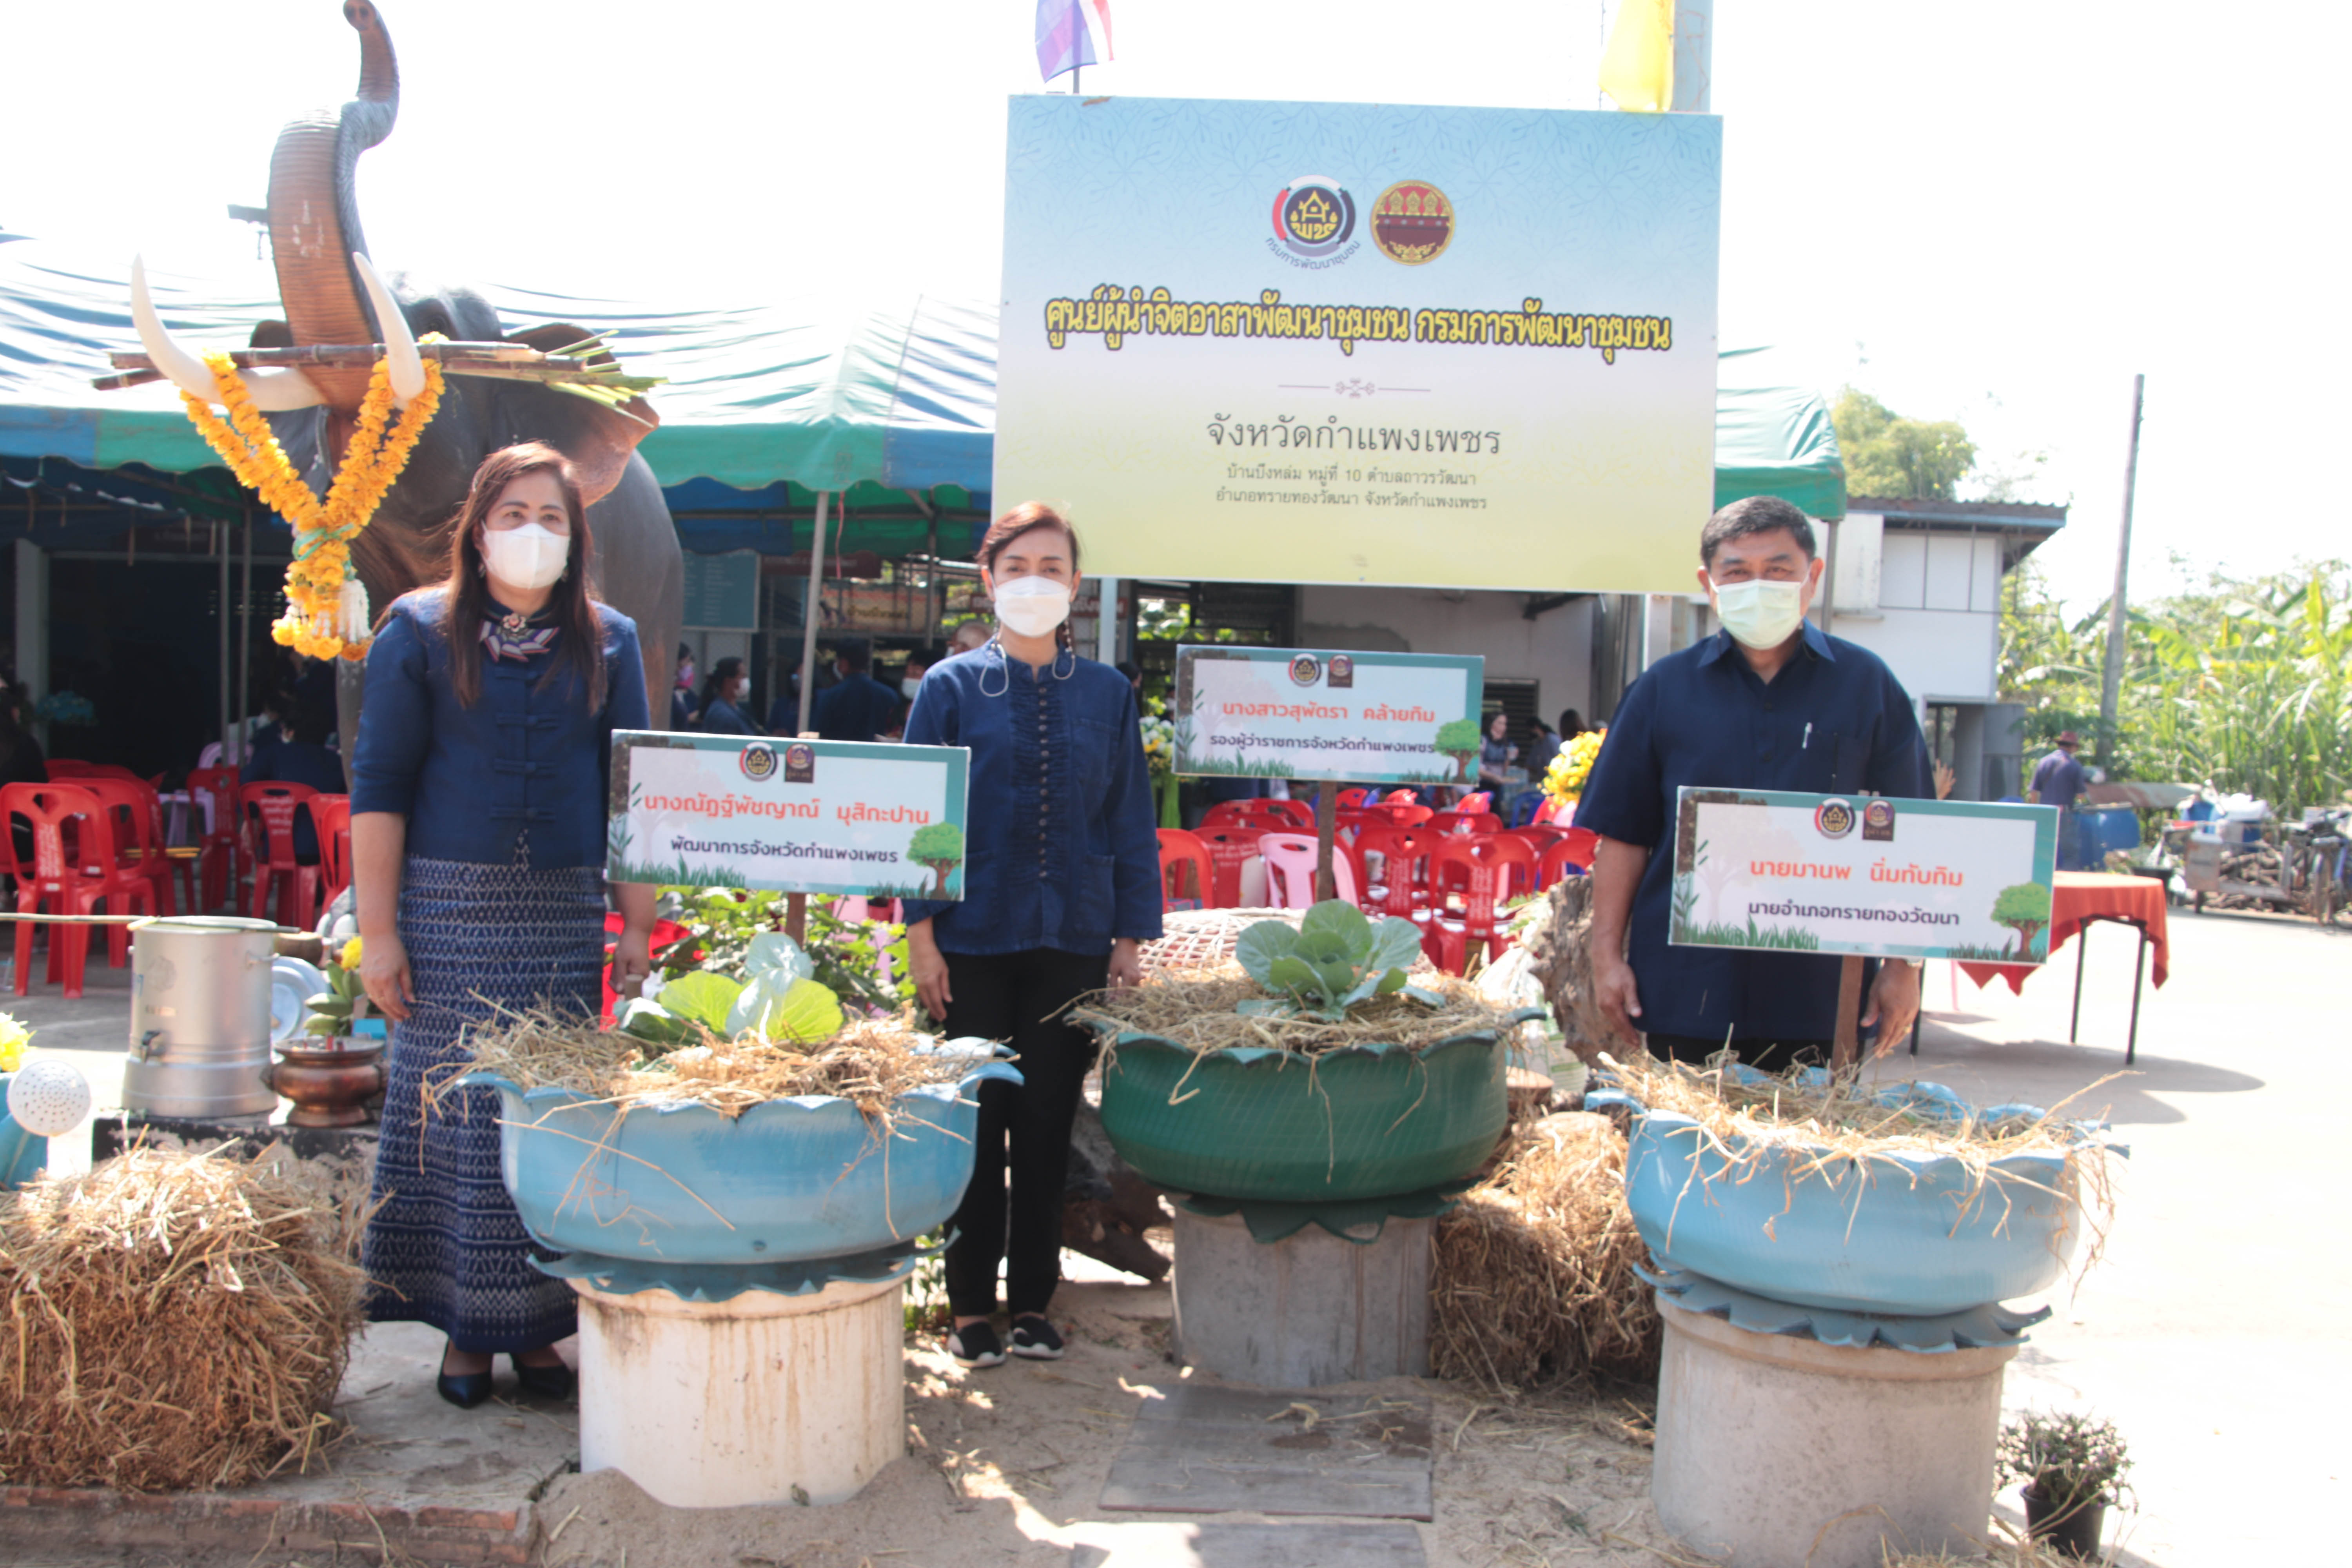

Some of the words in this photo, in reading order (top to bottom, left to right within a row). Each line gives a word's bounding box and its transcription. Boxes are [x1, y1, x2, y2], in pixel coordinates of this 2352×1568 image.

[1265, 237, 1361, 269] กรมการพัฒนาชุมชน
[1045, 283, 1410, 356] ศูนย์ผู้นำจิตอาสาพัฒนาชุมชน
[1415, 296, 1672, 365] กรมการพัฒนาชุมชน
[1207, 413, 1501, 454] จังหวัดกำแพงเพชร
[1227, 463, 1301, 480] บ้านบึงหล่ม
[1308, 462, 1338, 487] หมู่ที่
[1346, 469, 1361, 482] 10
[1367, 467, 1476, 485] ตำบลถาวรวัฒนา
[1216, 486, 1359, 505] อำเภอทรายทองวัฒนา
[1365, 491, 1487, 509] จังหวัดกำแพงเพชร
[1223, 701, 1348, 722] นางสาวสุพัตรา
[1363, 703, 1436, 723] คล้ายทิม
[1210, 732, 1436, 753] รองผู้ว่าราชการจังหวัดกำแพงเพชร
[837, 802, 929, 826] มุสิกะปาน
[670, 835, 898, 863] พัฒนาการจังหวัดกำแพงเพชร
[1750, 860, 1851, 880] นายมานพ
[1869, 857, 1964, 887] นิ่มทับทิม
[1748, 899, 1960, 925] นายอำเภอทรายทองวัฒนา
